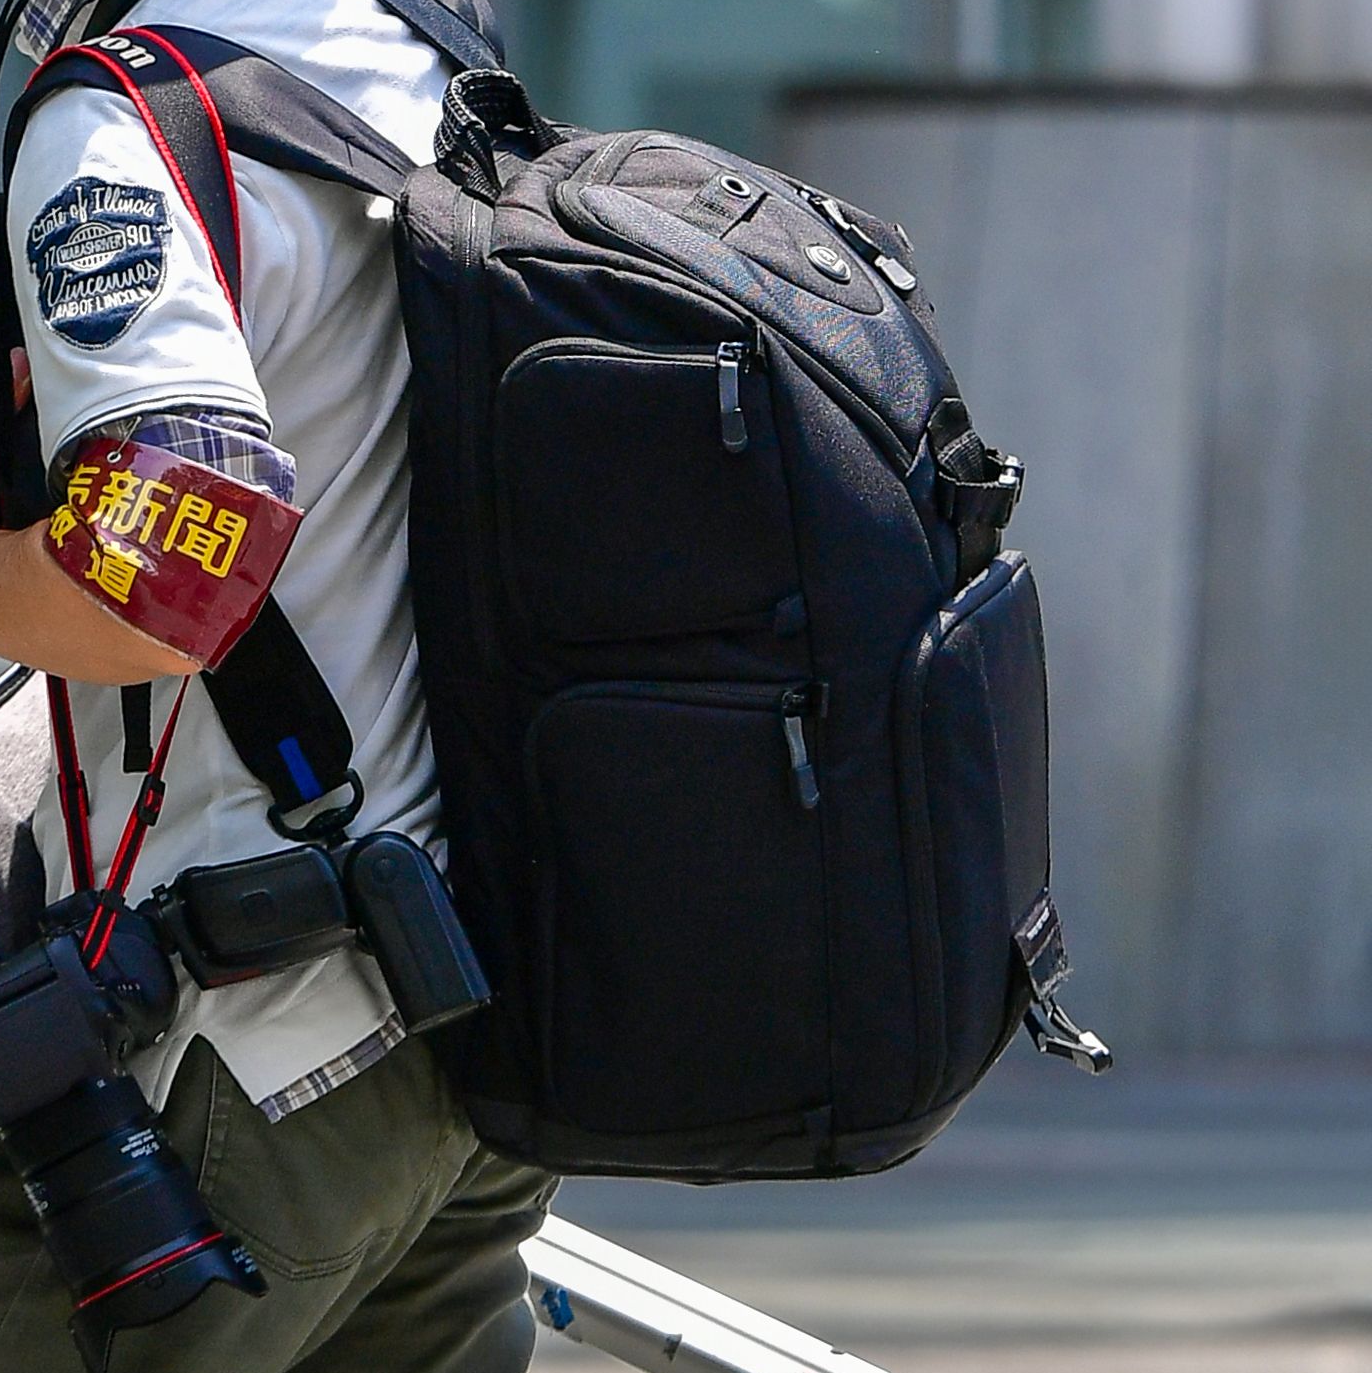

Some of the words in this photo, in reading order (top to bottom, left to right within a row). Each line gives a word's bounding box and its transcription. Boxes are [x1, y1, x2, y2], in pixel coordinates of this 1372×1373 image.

[81, 34, 157, 69] on
[31, 206, 69, 250] State
[69, 185, 88, 223] of
[91, 186, 156, 218] Illinois
[126, 224, 154, 246] 90
[42, 259, 160, 308] Vincennes
[79, 298, 95, 316] OF
